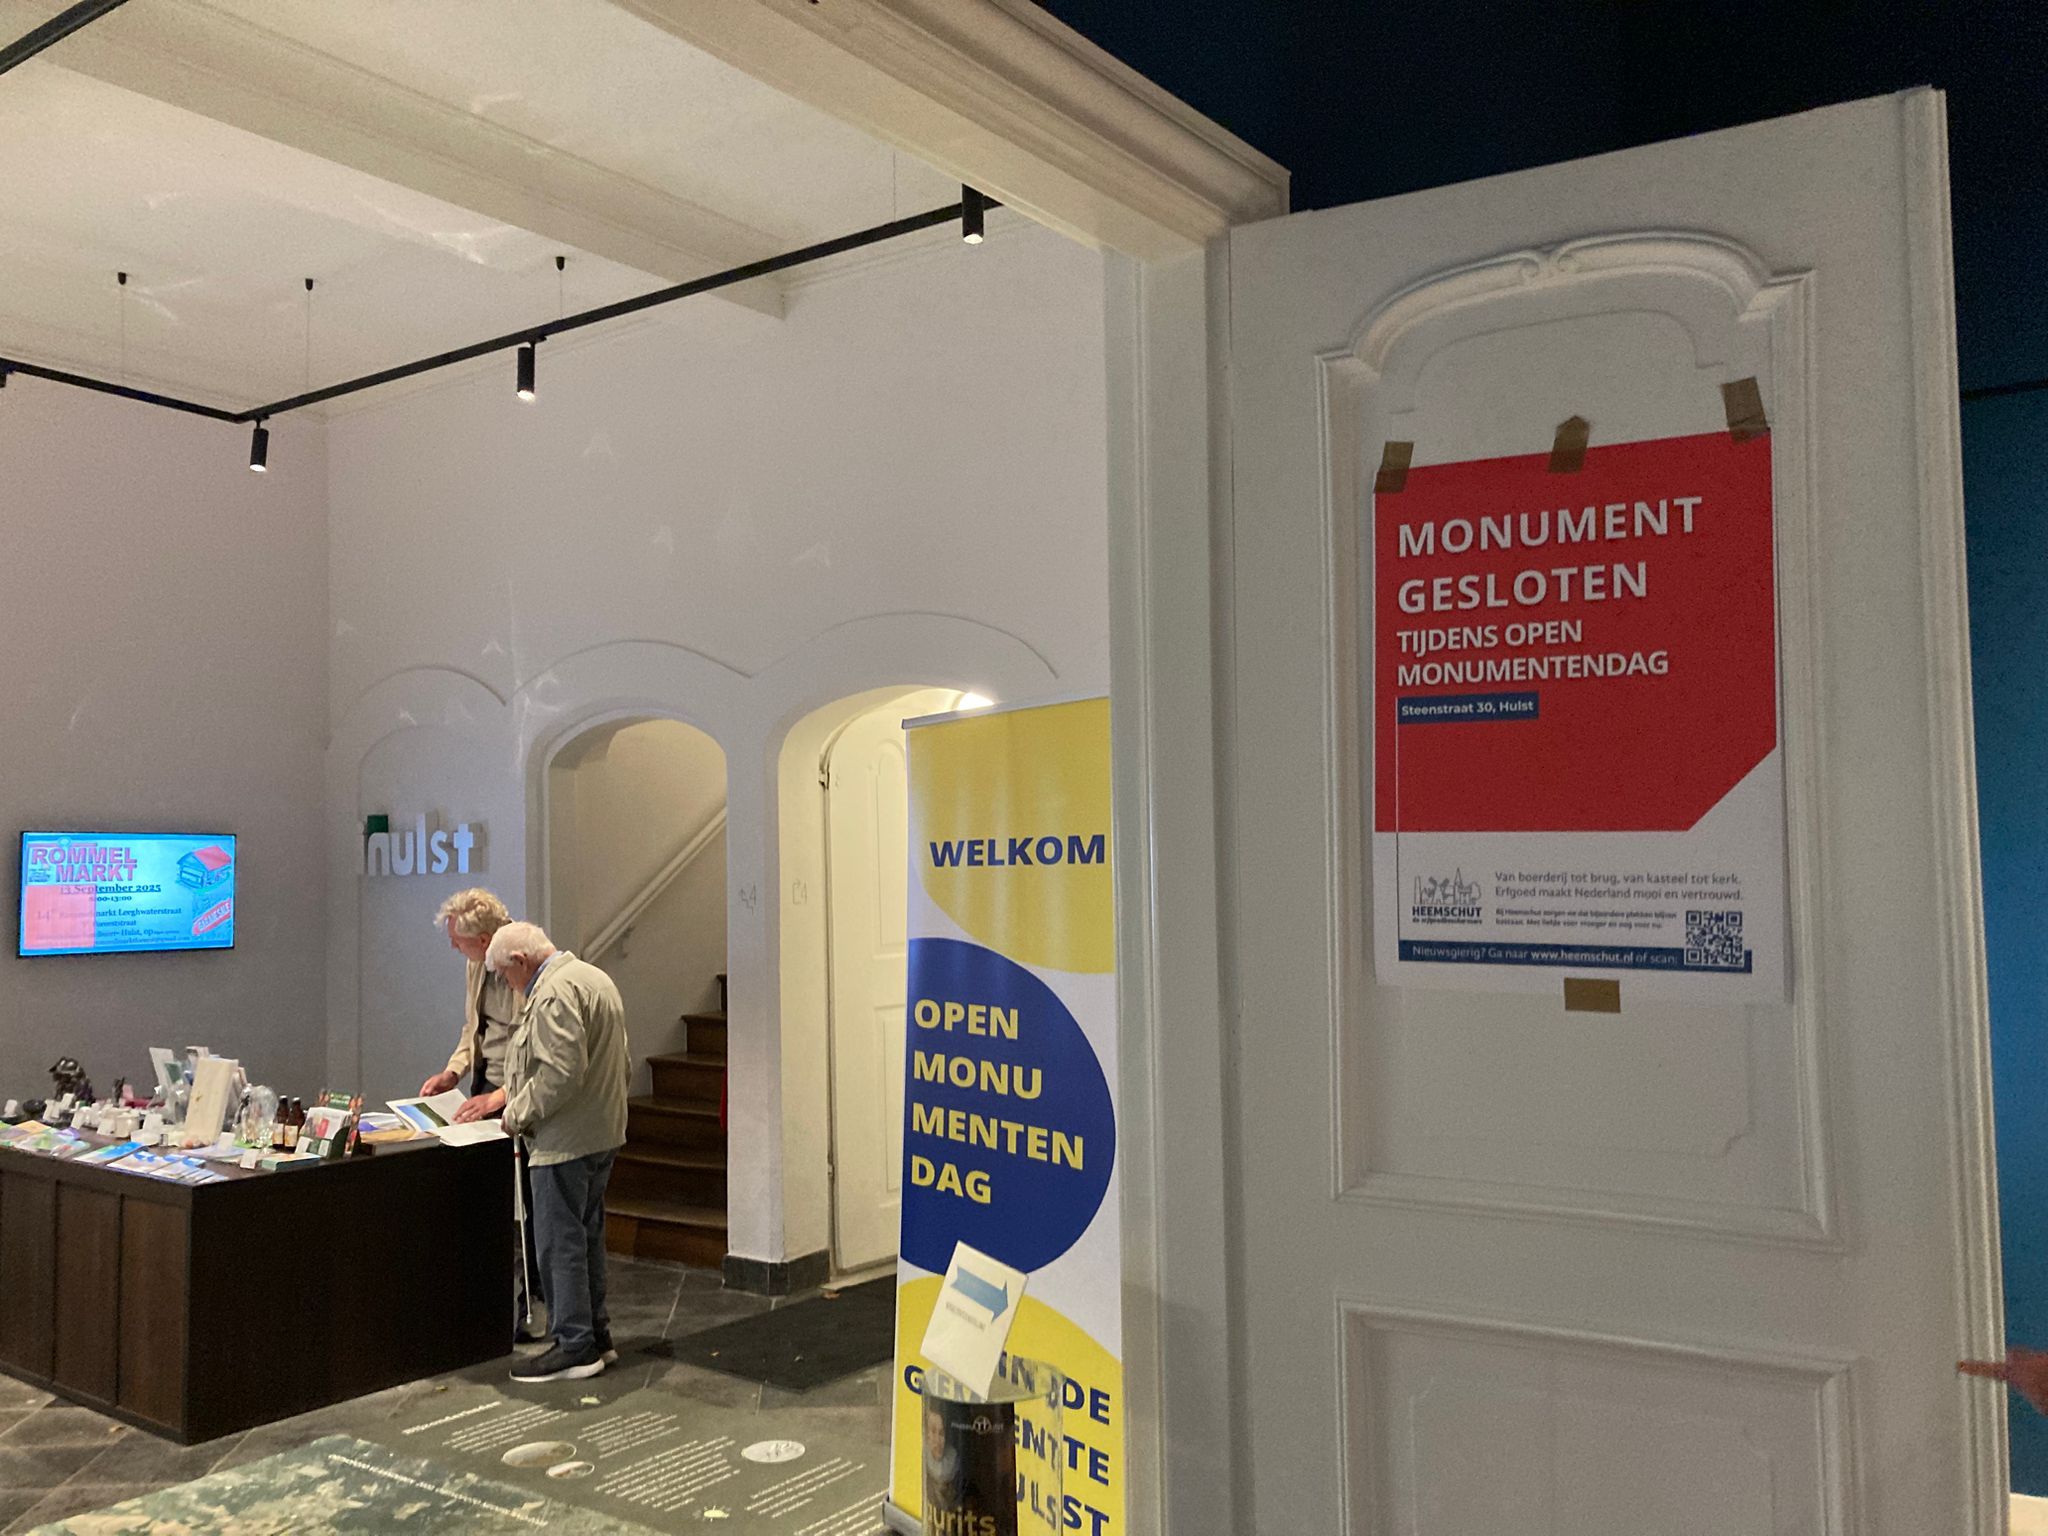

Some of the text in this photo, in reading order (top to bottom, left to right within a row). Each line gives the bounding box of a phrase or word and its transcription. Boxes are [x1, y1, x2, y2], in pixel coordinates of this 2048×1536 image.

[1399, 496, 1703, 558] MONUMENT
[1398, 561, 1647, 614] GESLOTEN
[1397, 620, 1582, 657] TIJDENS OPEN
[1397, 650, 1669, 687] MONUMENTENDAG
[1402, 700, 1534, 716] Steenstraat 30, Hulst
[31, 847, 138, 865] ROMMEL
[929, 834, 1105, 867] WELKOM
[56, 864, 138, 882] MARKT
[135, 884, 162, 894] 2025
[1495, 872, 1515, 882] Van
[1519, 872, 1568, 885] boerderij
[1571, 873, 1587, 883] tot
[1623, 875, 1644, 883] van
[1647, 873, 1687, 884] kasteel
[1691, 874, 1708, 884] tot
[1495, 886, 1536, 899] Erfgoed
[1538, 886, 1571, 897] maakt
[1575, 888, 1631, 899] Nederland
[1633, 889, 1662, 899] mooi
[1664, 890, 1678, 899] en
[1412, 906, 1482, 917] HEEMSCHUT
[1412, 946, 1486, 960] Nieuwsgierig?
[1488, 948, 1501, 958] Ga
[1505, 949, 1528, 959] naar
[1531, 949, 1633, 963] www.heemschut.nl
[1636, 952, 1647, 962] of
[914, 999, 1018, 1040] OPEN
[913, 1050, 1042, 1099] MONU
[912, 1102, 1084, 1171] MENTEN
[911, 1154, 991, 1204] DAG
